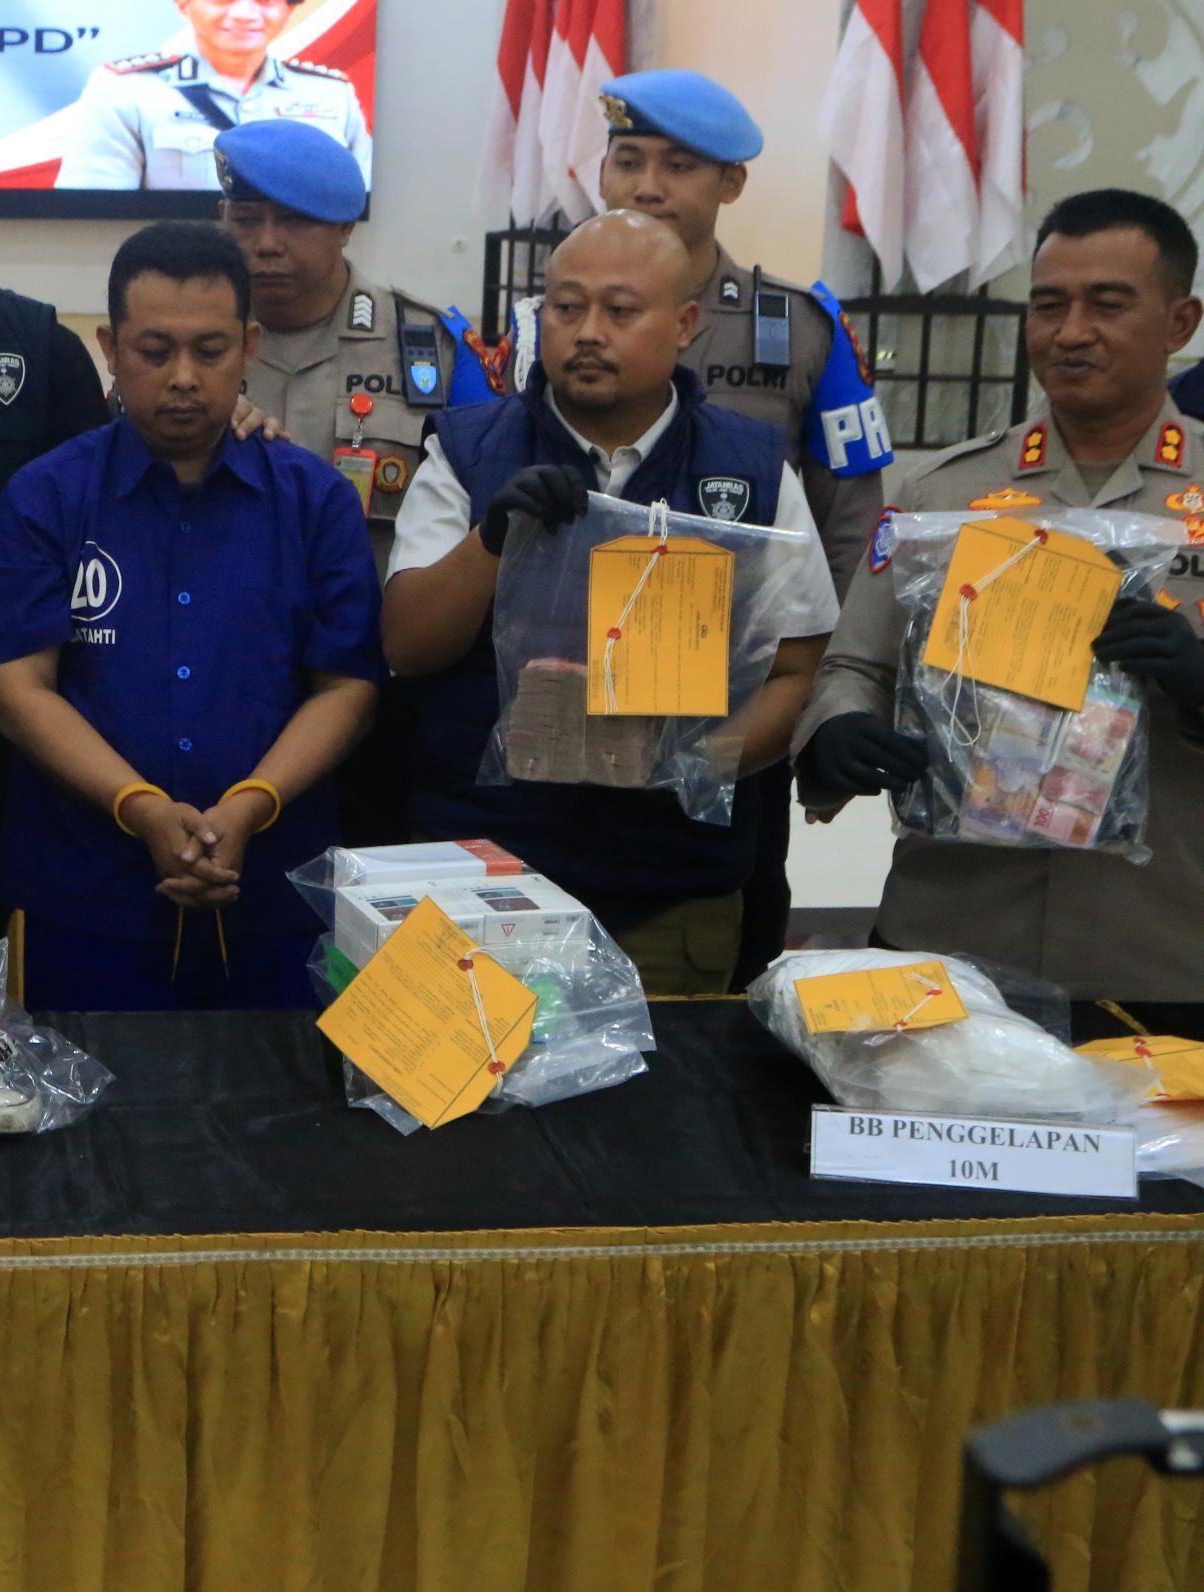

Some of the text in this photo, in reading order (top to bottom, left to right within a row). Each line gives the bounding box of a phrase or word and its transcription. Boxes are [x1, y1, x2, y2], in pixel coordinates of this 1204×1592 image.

[346, 373, 401, 395] POL
[849, 1115, 1101, 1153] BB PENGGELAPAN
[949, 1158, 1000, 1182] 10M
